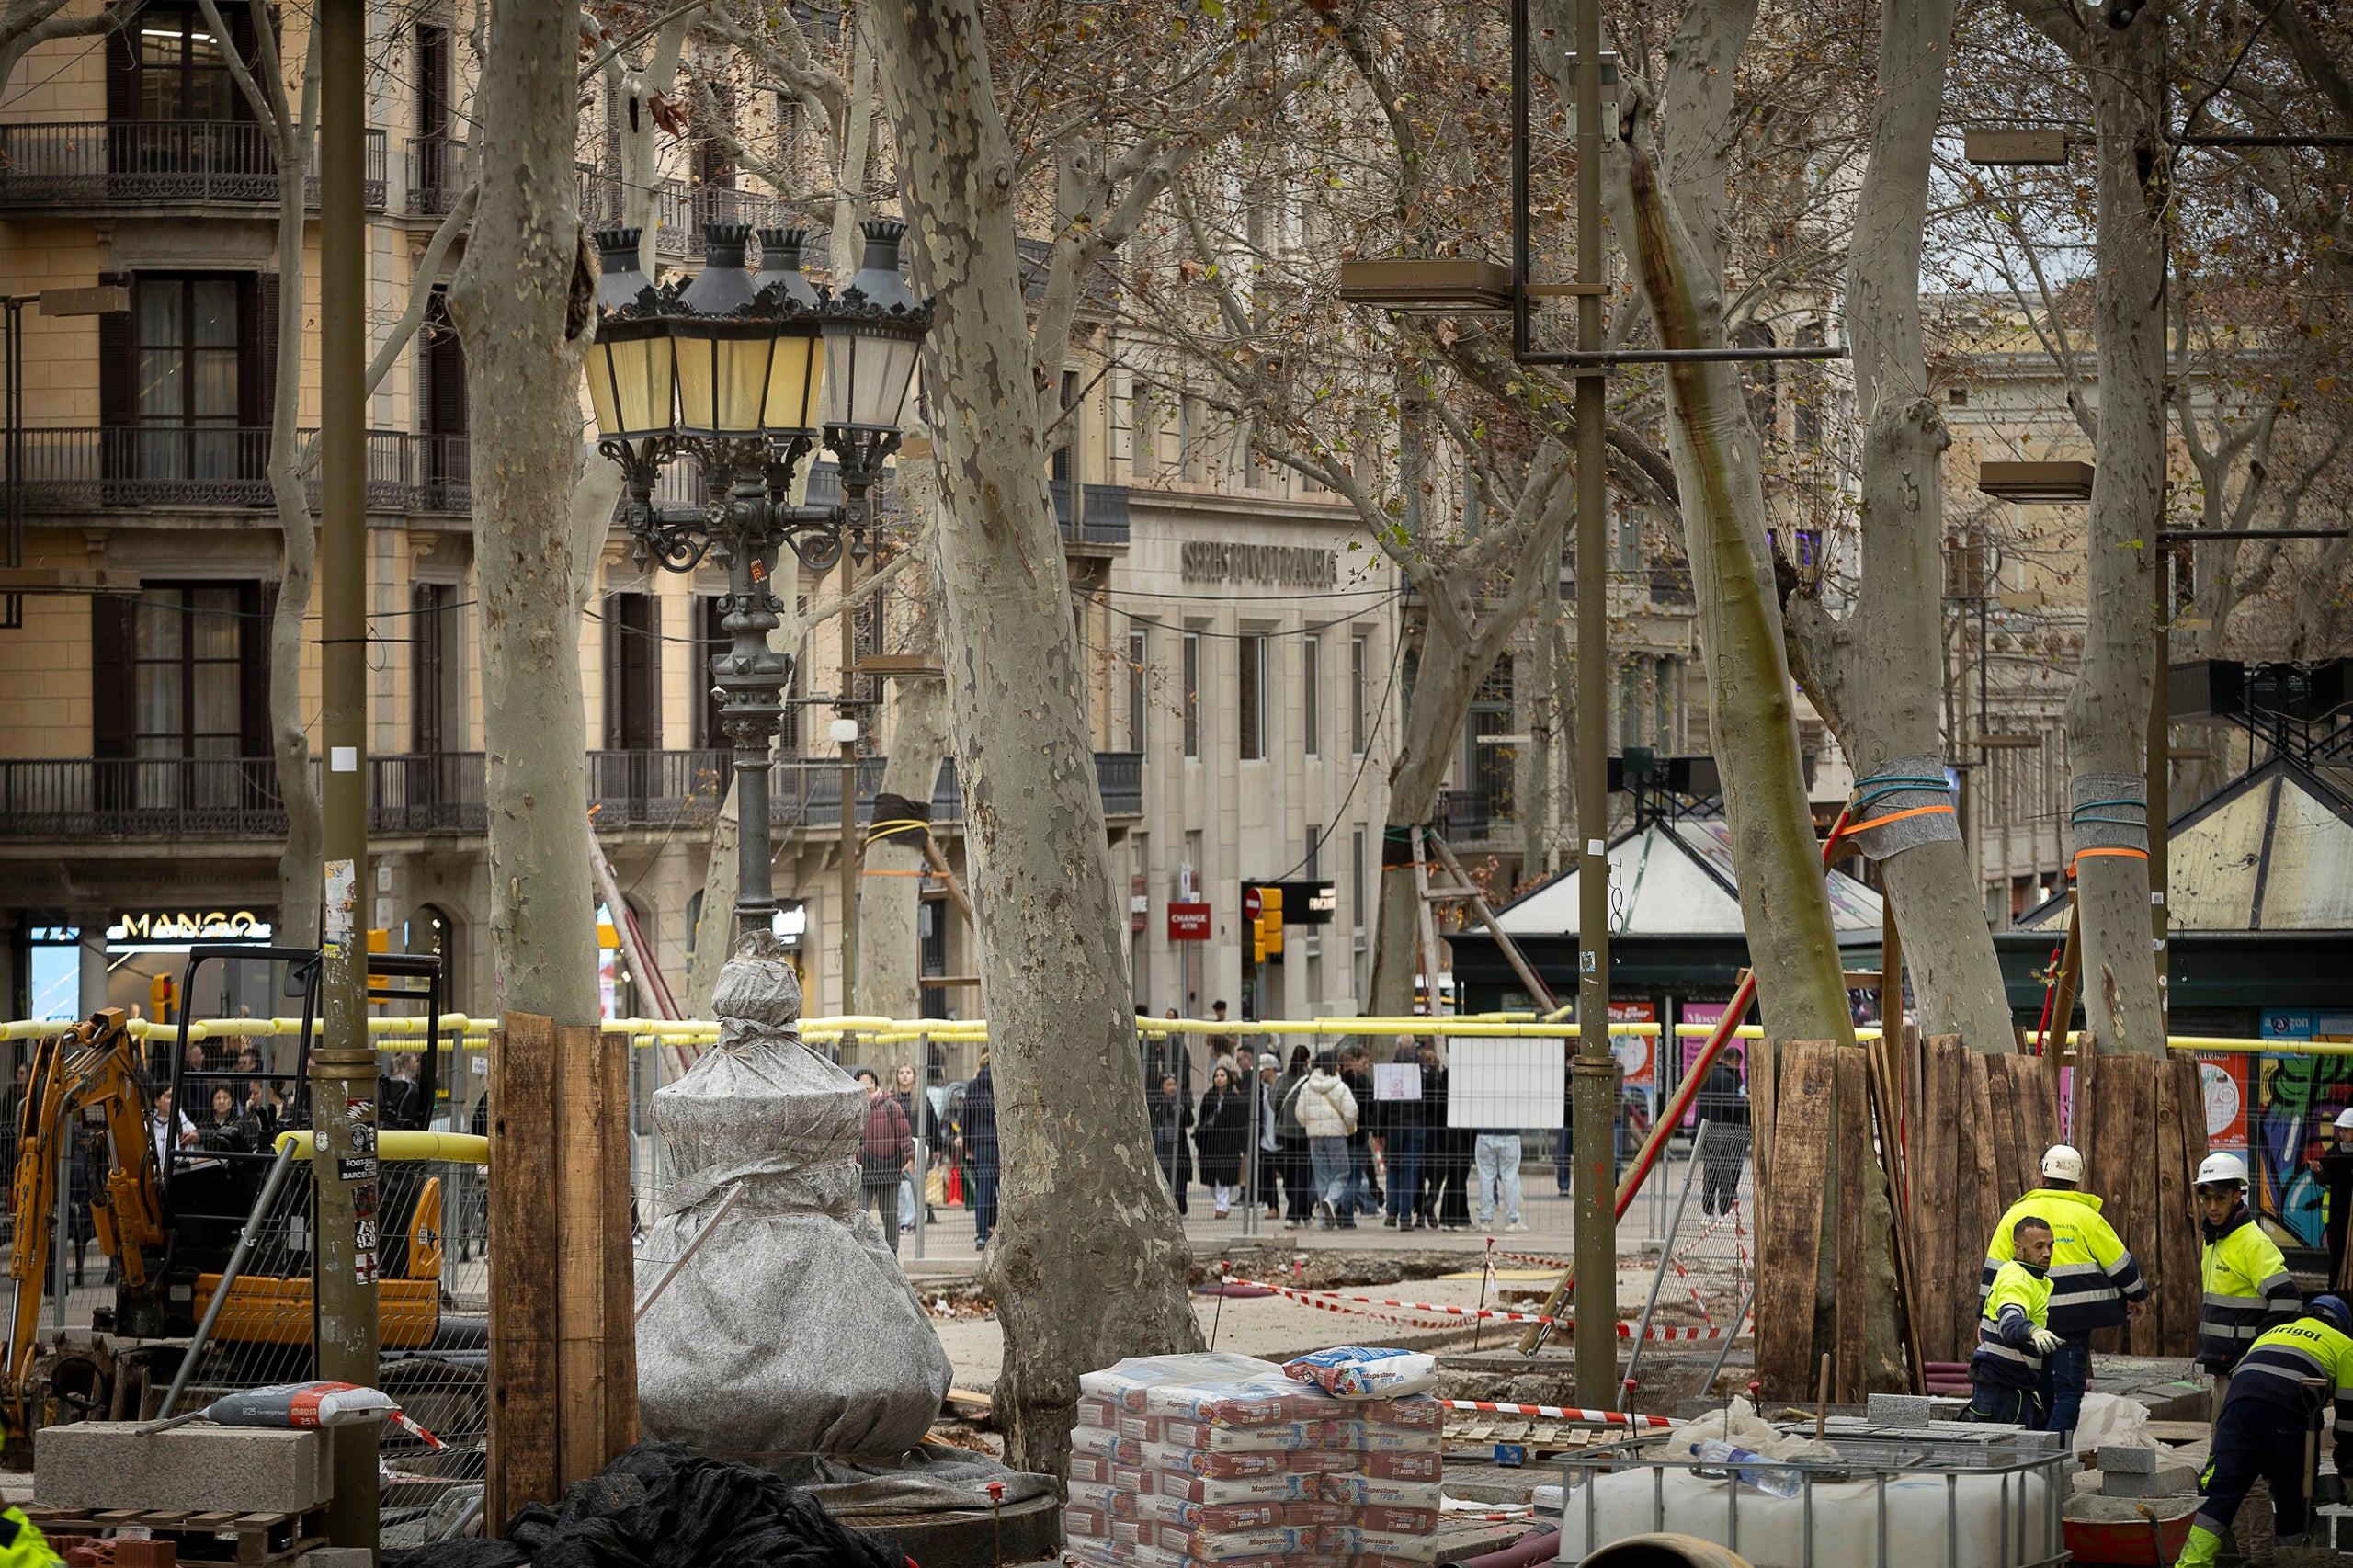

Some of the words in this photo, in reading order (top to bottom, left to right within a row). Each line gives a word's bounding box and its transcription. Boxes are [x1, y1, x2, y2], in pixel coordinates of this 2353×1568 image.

[1171, 914, 1207, 924] CHANGE
[121, 911, 256, 938] MANGO
[1362, 1371, 1397, 1381] Mapestone
[291, 1407, 318, 1416] MAUSA
[301, 1417, 312, 1426] 25
[1256, 1430, 1293, 1440] Mapestone
[1360, 1430, 1399, 1439] Mapestone
[1251, 1484, 1290, 1494] Mapestone
[1360, 1486, 1400, 1494] Mapestone
[1249, 1538, 1288, 1547] Mapestone
[1355, 1536, 1394, 1545] Mapestone
